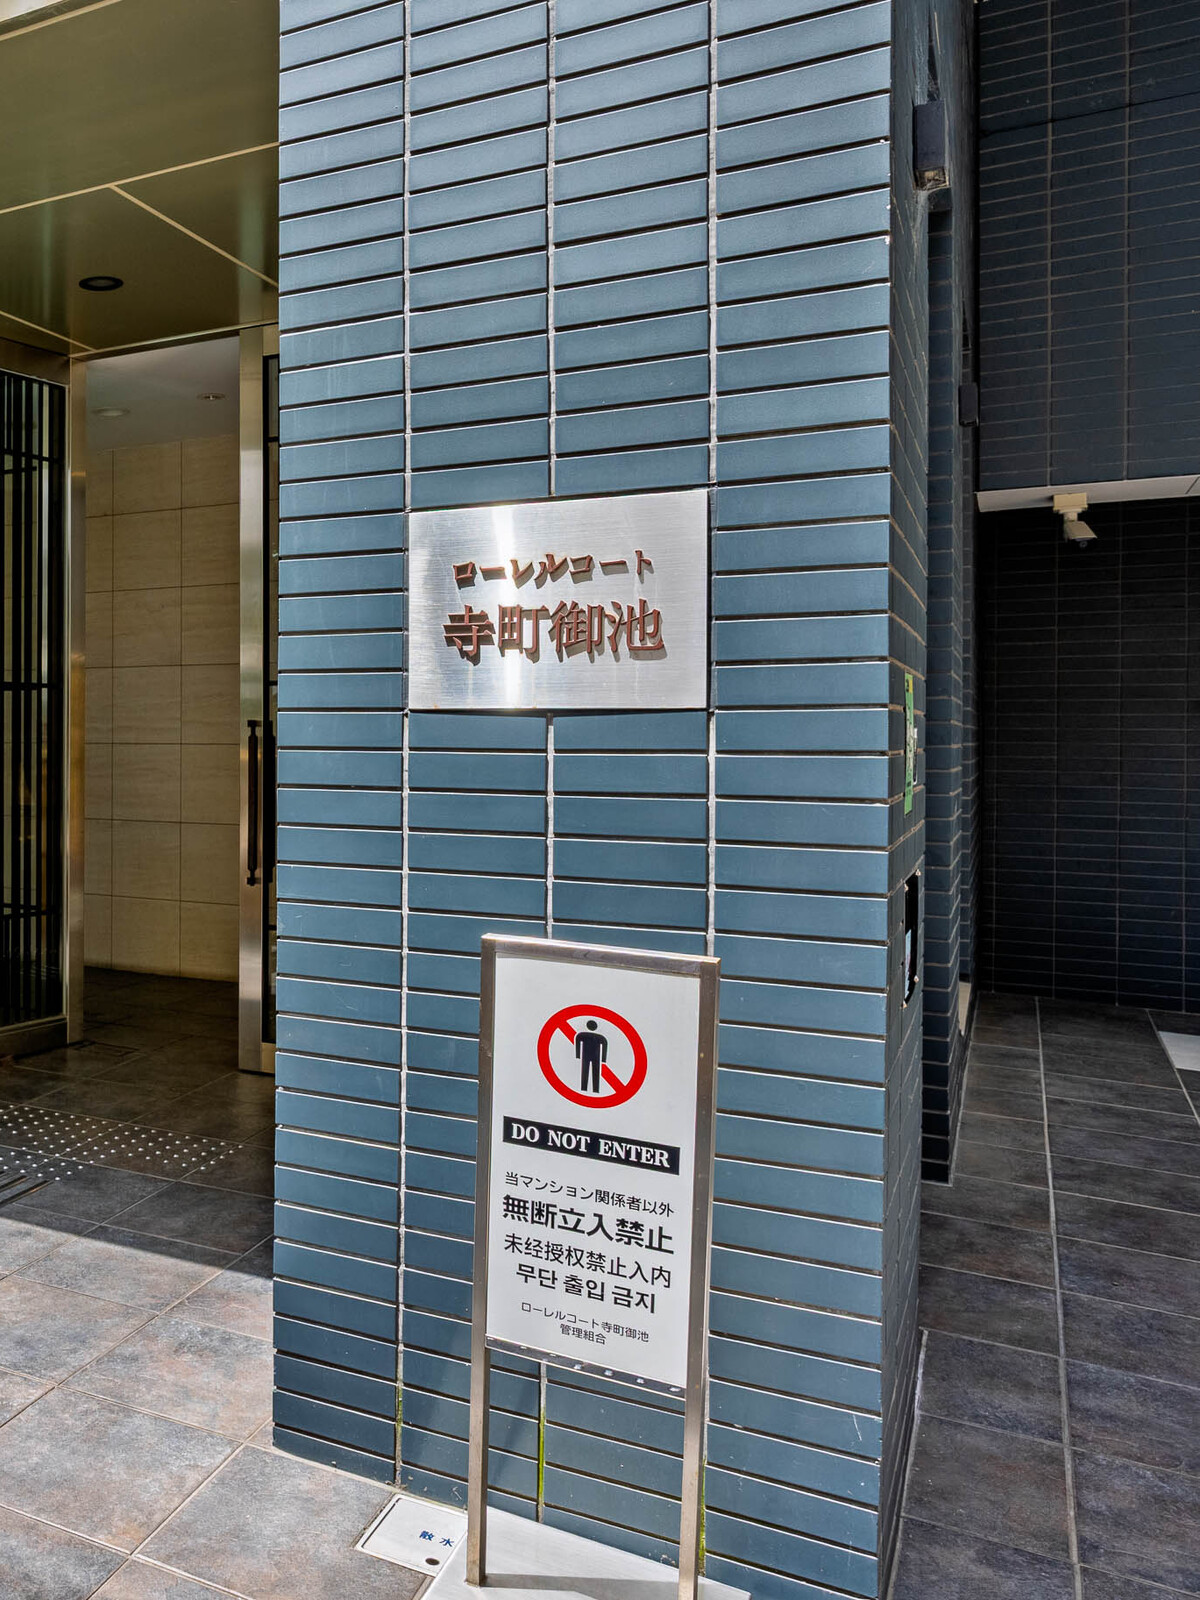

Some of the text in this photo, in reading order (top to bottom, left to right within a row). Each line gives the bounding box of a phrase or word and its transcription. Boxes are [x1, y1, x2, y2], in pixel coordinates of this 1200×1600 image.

[452, 550, 653, 583] ローレルコート
[441, 598, 665, 656] 寺町御池
[511, 1122, 671, 1169] DO NOT ENTER
[504, 1171, 675, 1218] 当マンション関係者以外
[502, 1194, 675, 1255] 無断立入禁止
[504, 1232, 672, 1289] 未经授权禁止入内
[515, 1262, 656, 1314] 무단 출입 금지
[521, 1301, 650, 1343] ローレルコート寺町御池
[559, 1323, 607, 1345] 管理組合
